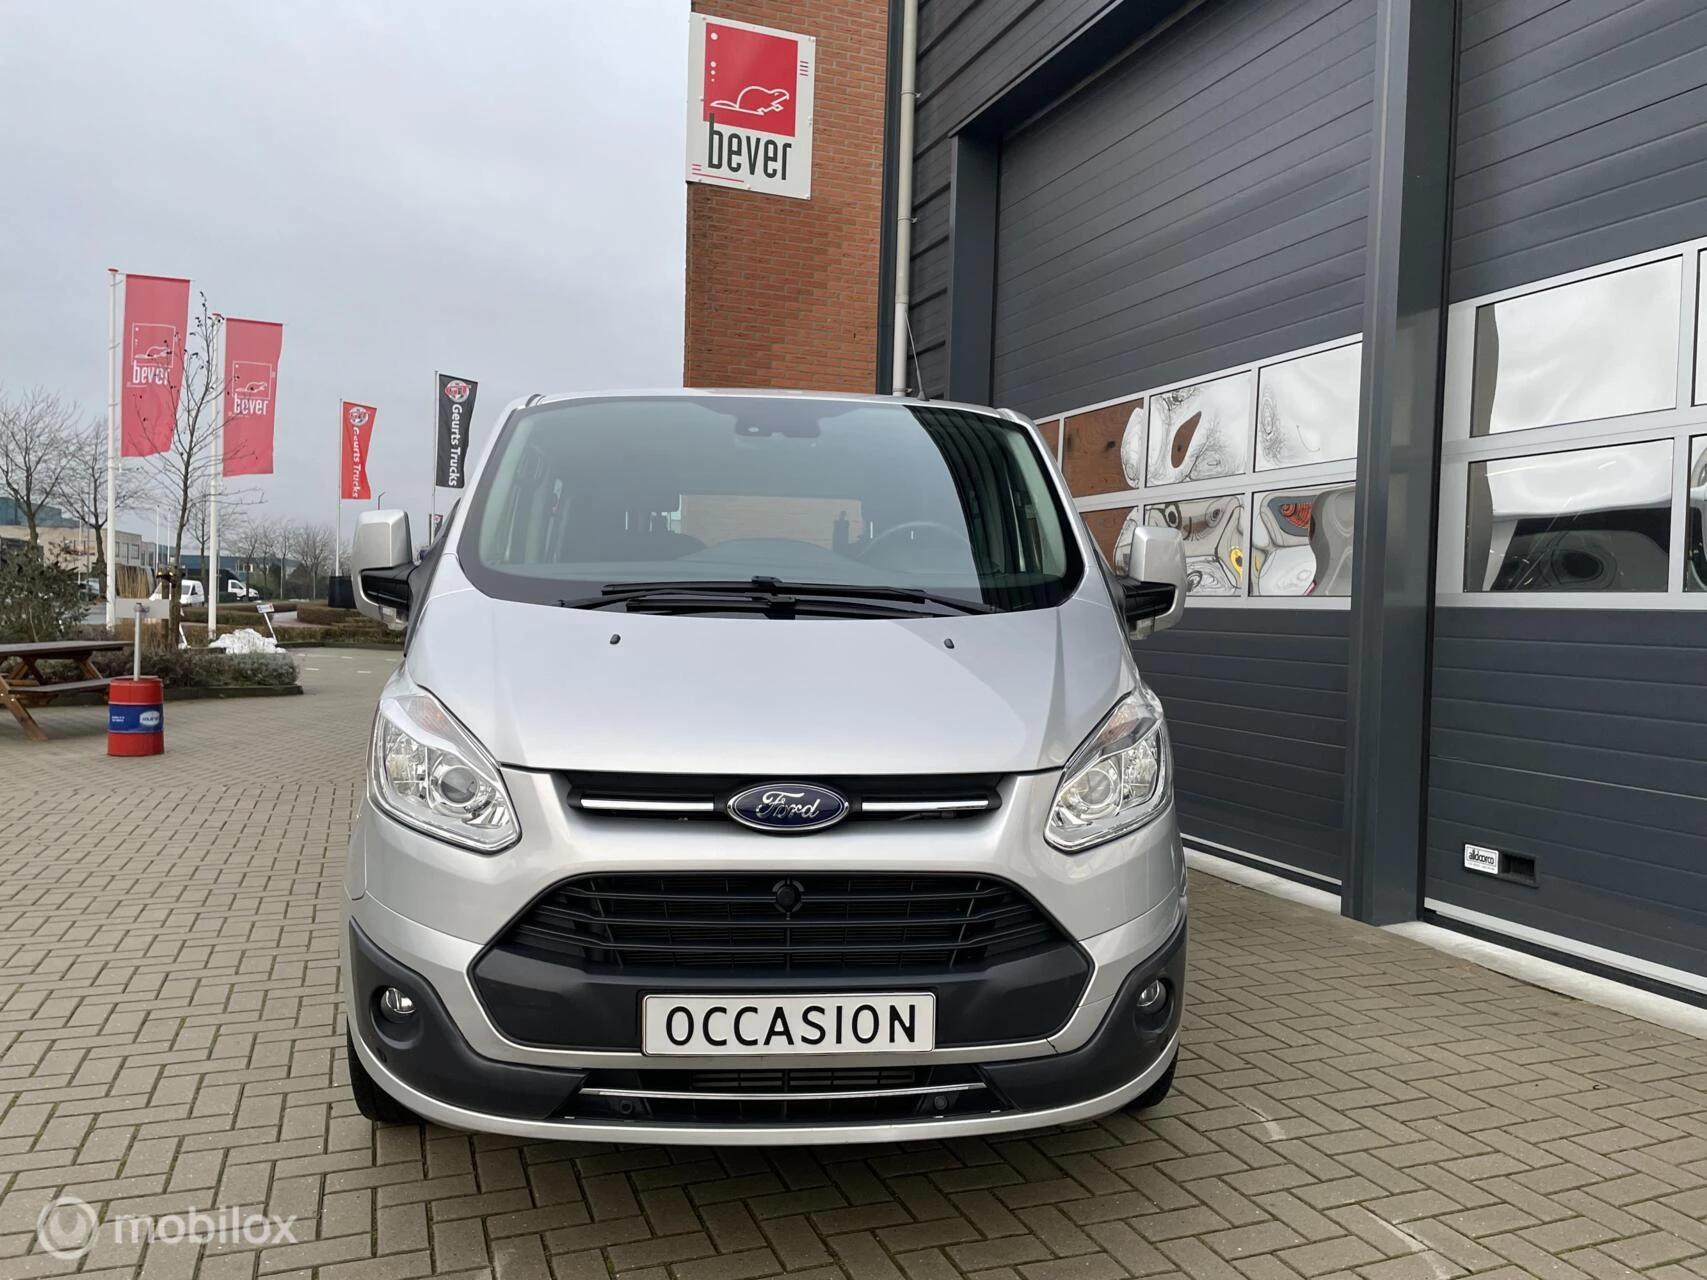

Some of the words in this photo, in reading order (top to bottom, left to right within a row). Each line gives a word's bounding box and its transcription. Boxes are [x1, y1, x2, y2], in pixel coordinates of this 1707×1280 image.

[708, 112, 792, 180] bever
[132, 359, 171, 385] bever
[233, 392, 269, 415] bever
[451, 404, 462, 445] Geurts
[449, 447, 461, 486] Trucks
[756, 791, 820, 818] Ford
[665, 1004, 917, 1046] OCCASION
